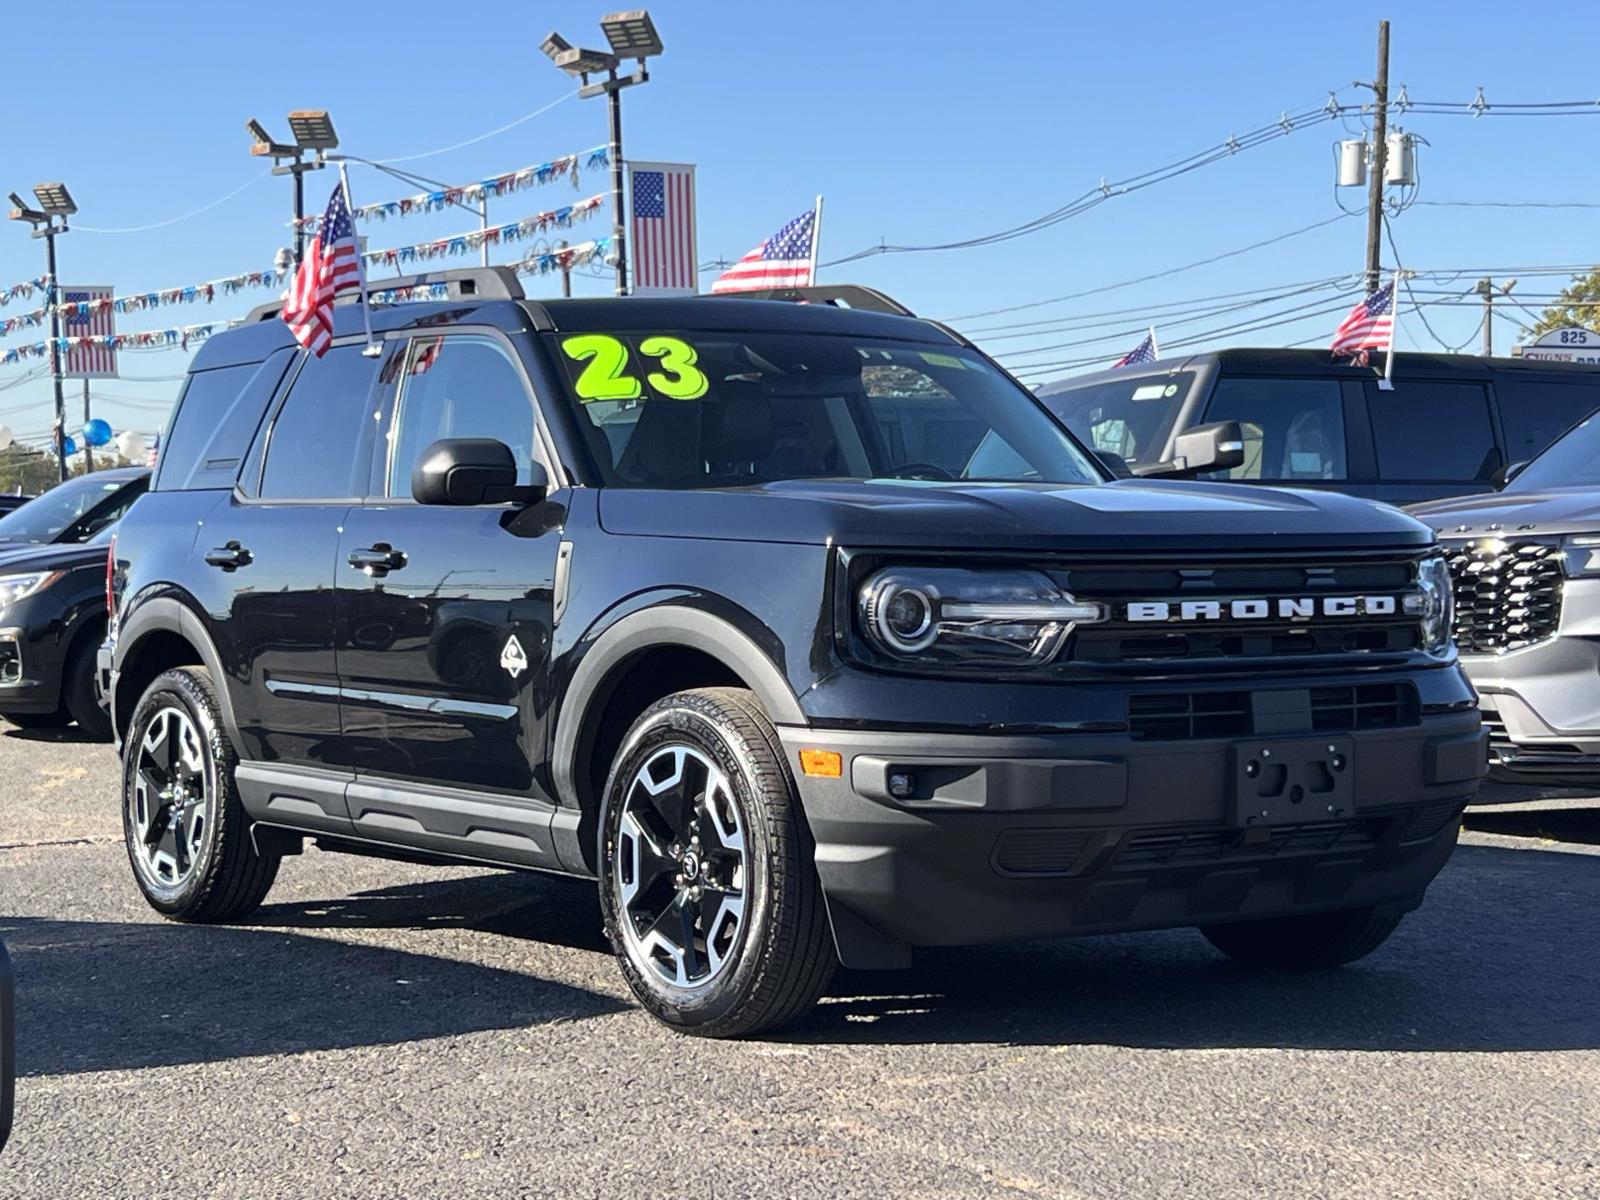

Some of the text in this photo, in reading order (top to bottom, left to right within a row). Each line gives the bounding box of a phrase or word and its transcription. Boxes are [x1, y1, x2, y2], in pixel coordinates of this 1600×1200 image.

[1560, 331, 1587, 344] 825
[562, 334, 709, 400] 23
[1126, 596, 1395, 622] BRONCO
